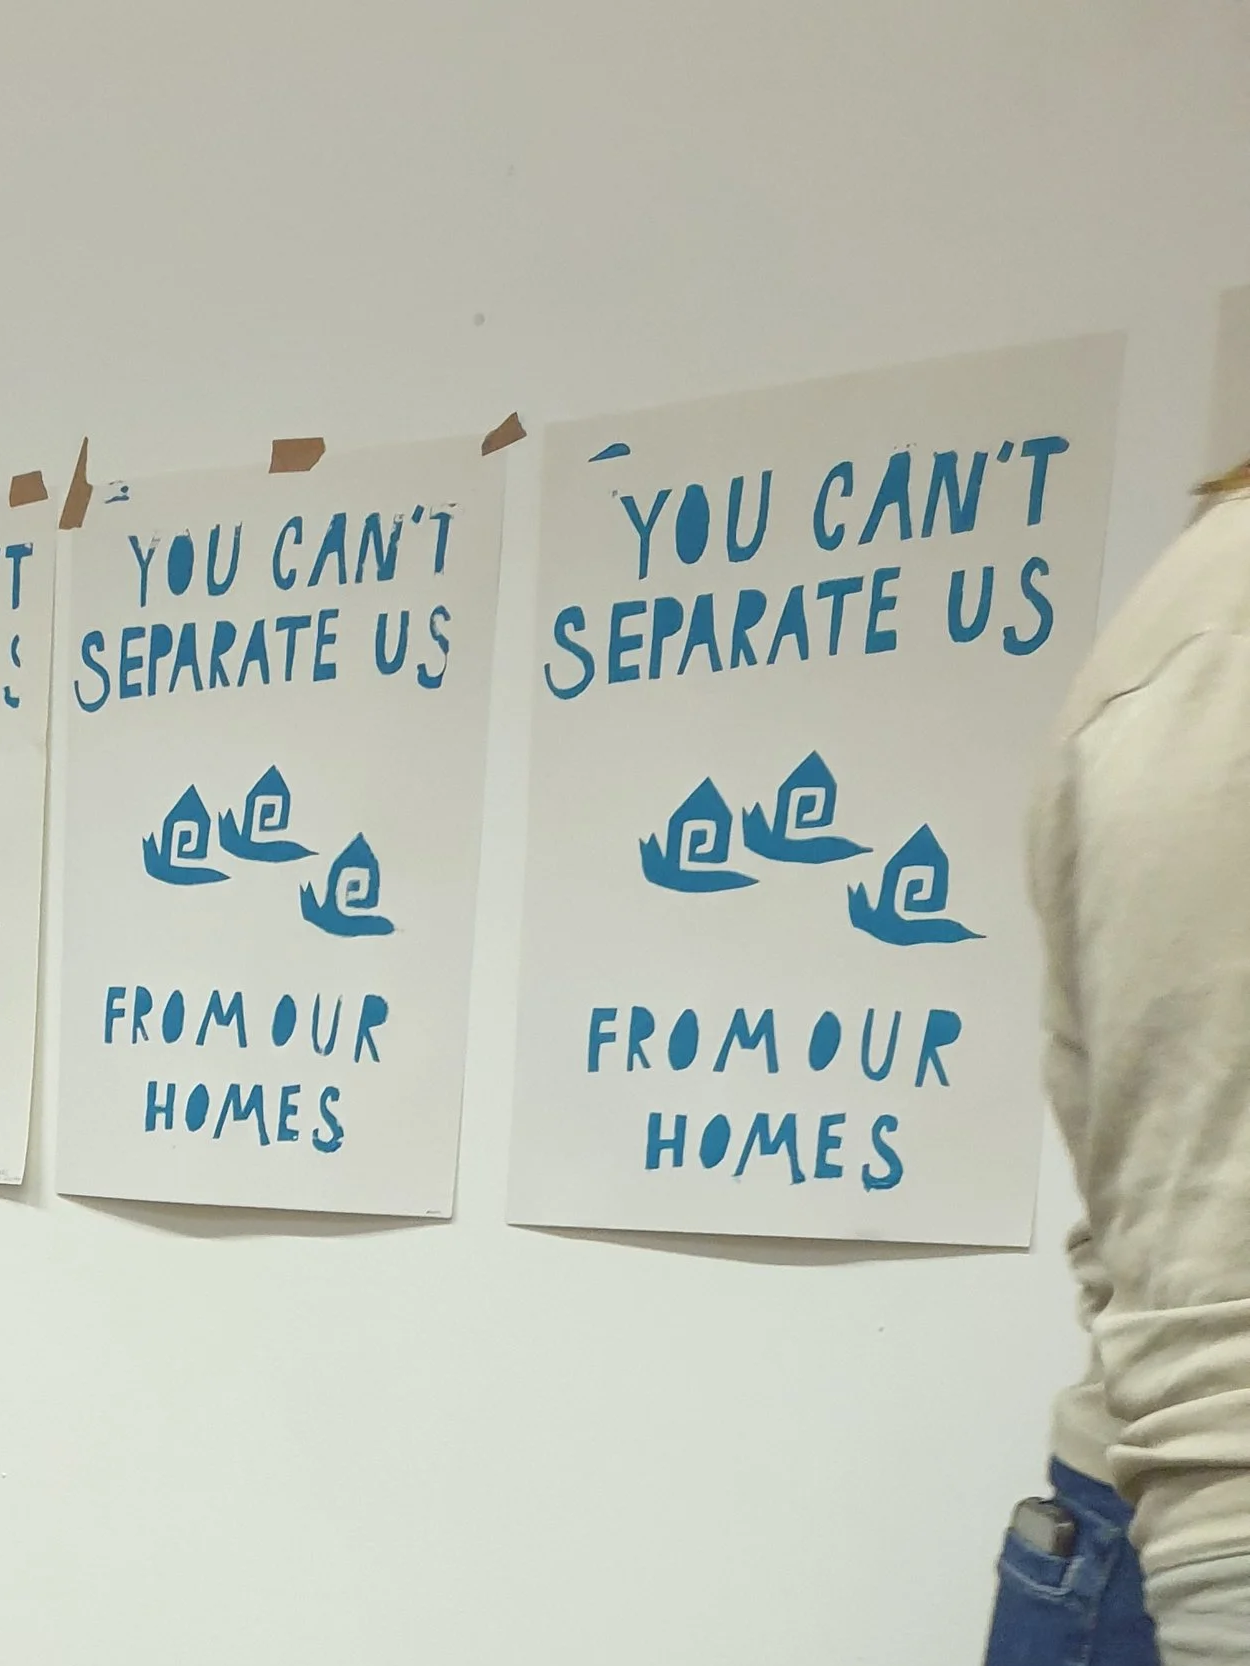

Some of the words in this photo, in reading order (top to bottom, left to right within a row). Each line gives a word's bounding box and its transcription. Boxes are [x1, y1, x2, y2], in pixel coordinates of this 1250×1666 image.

[620, 470, 772, 580] YOU
[812, 436, 1069, 551] CAN'T
[129, 522, 242, 607] YOU
[272, 504, 456, 590] CAN'T
[74, 608, 338, 713] SEPARATE
[374, 605, 451, 690] US
[544, 566, 900, 701] SEPARATE
[947, 556, 1054, 657] US
[104, 985, 248, 1049] FROM
[271, 993, 389, 1063] OUR
[587, 1006, 779, 1074] FROM
[808, 1008, 963, 1088] OUR
[144, 1080, 345, 1154] HOMES
[645, 1112, 904, 1192] HOMES
